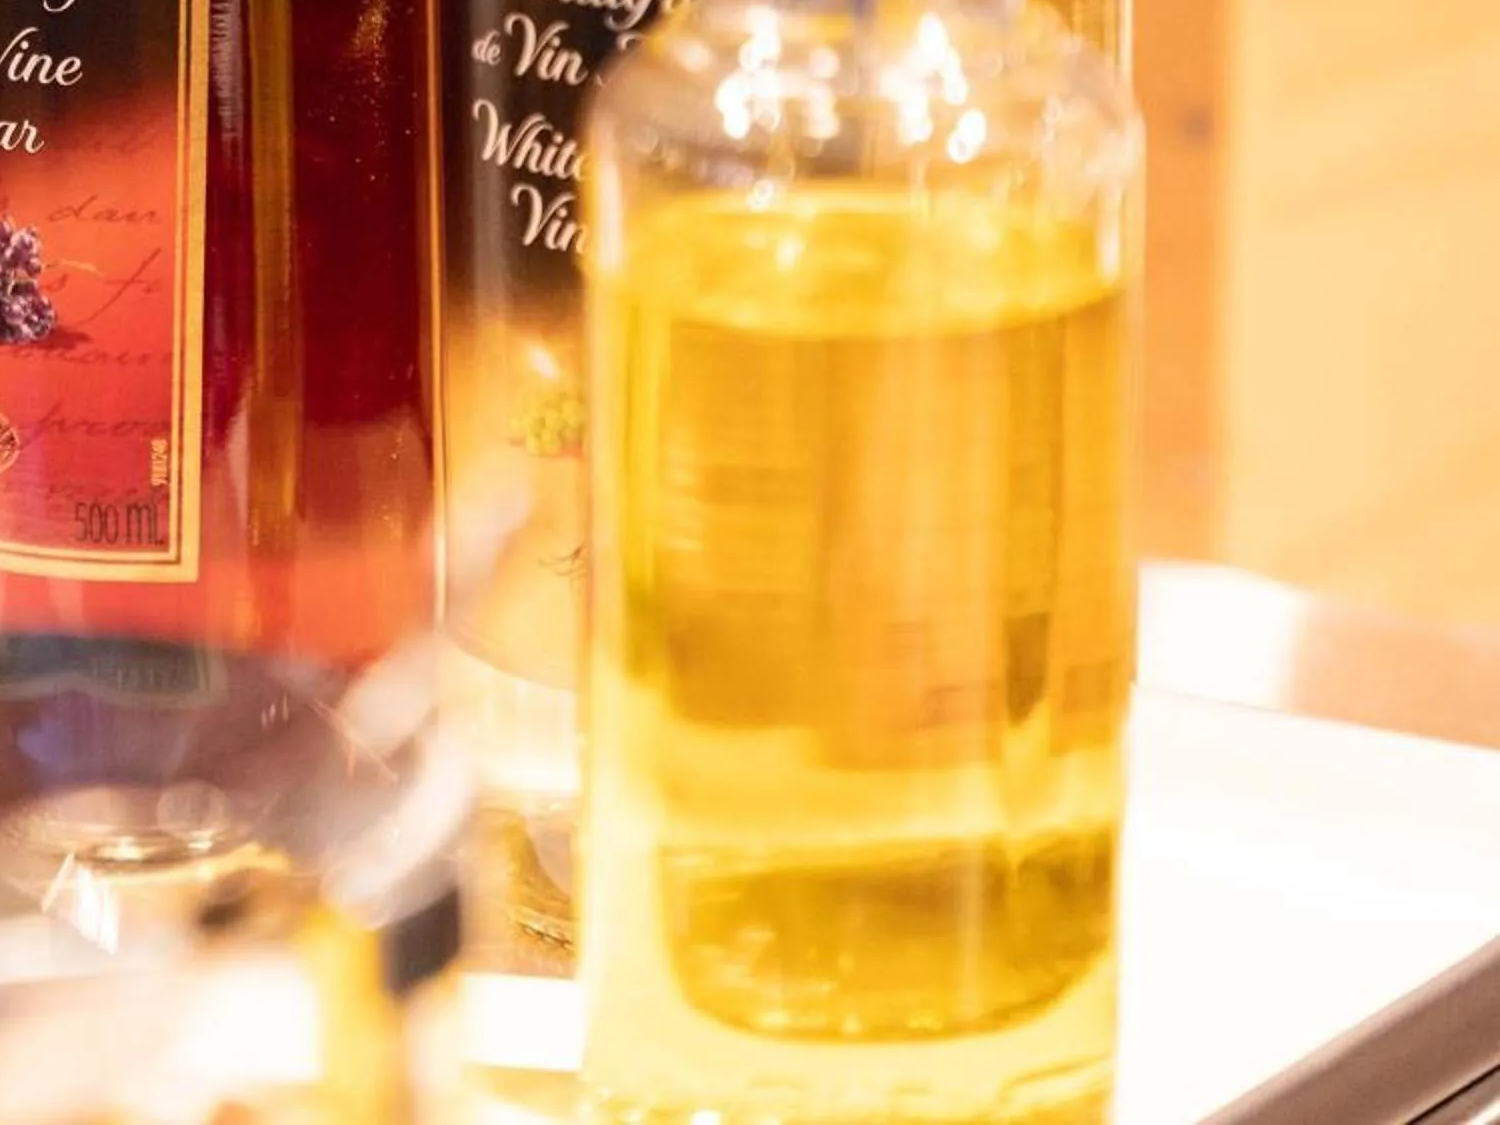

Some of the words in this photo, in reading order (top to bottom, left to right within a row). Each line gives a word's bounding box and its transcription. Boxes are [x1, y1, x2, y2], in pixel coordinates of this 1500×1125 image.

[472, 30, 501, 66] de
[504, 12, 589, 86] Vin
[74, 502, 119, 544] 500
